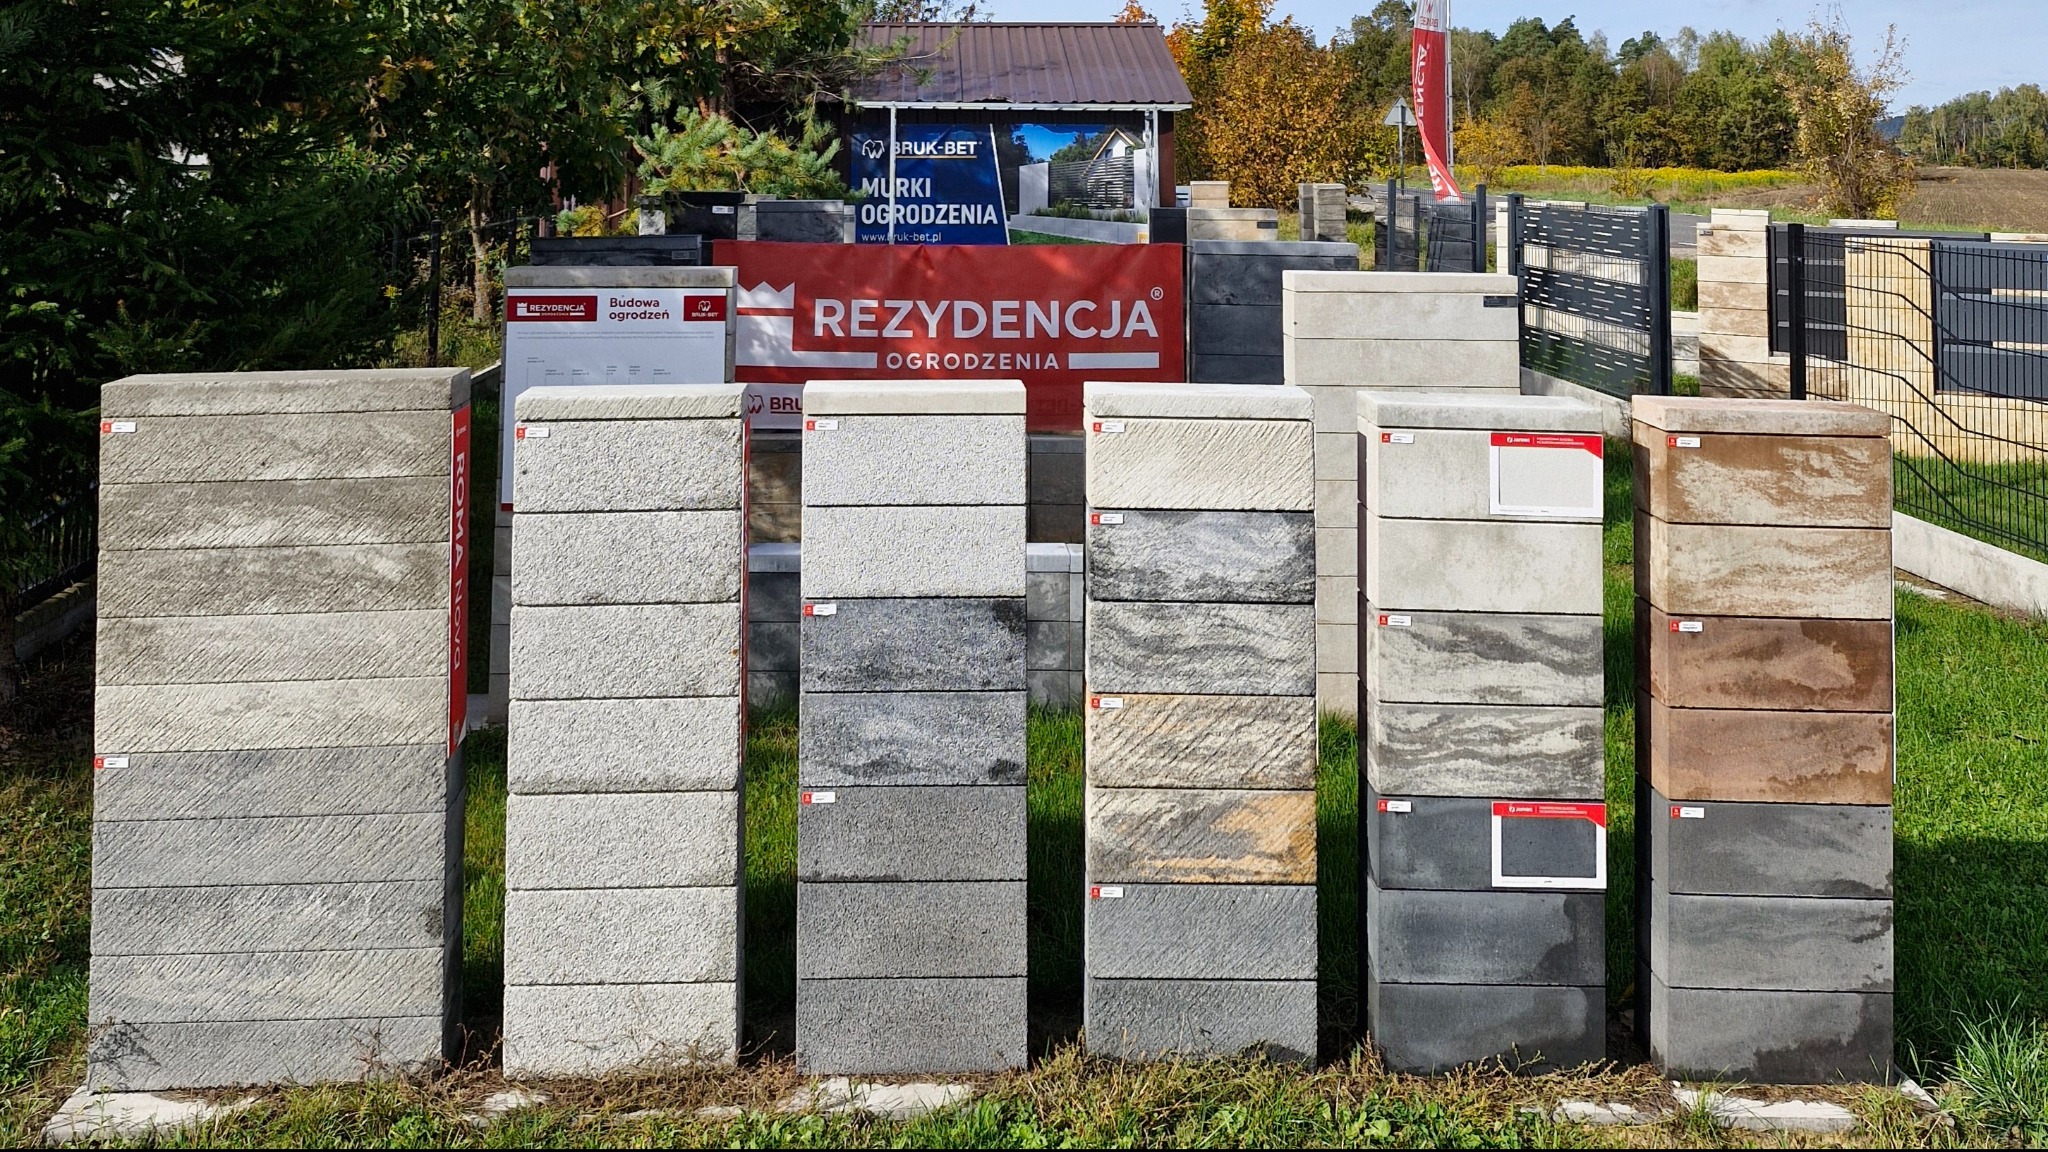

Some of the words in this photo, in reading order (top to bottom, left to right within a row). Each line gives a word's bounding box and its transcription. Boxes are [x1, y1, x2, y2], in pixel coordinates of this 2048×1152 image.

[862, 178, 931, 198] MURKI
[861, 204, 999, 225] OGRODZENIA
[529, 304, 586, 312] REZYDENCJA
[609, 297, 660, 308] Budowa
[609, 309, 670, 322] ogrodzeń
[886, 352, 1060, 370] OGRODZENIA
[456, 451, 465, 570] ROMA
